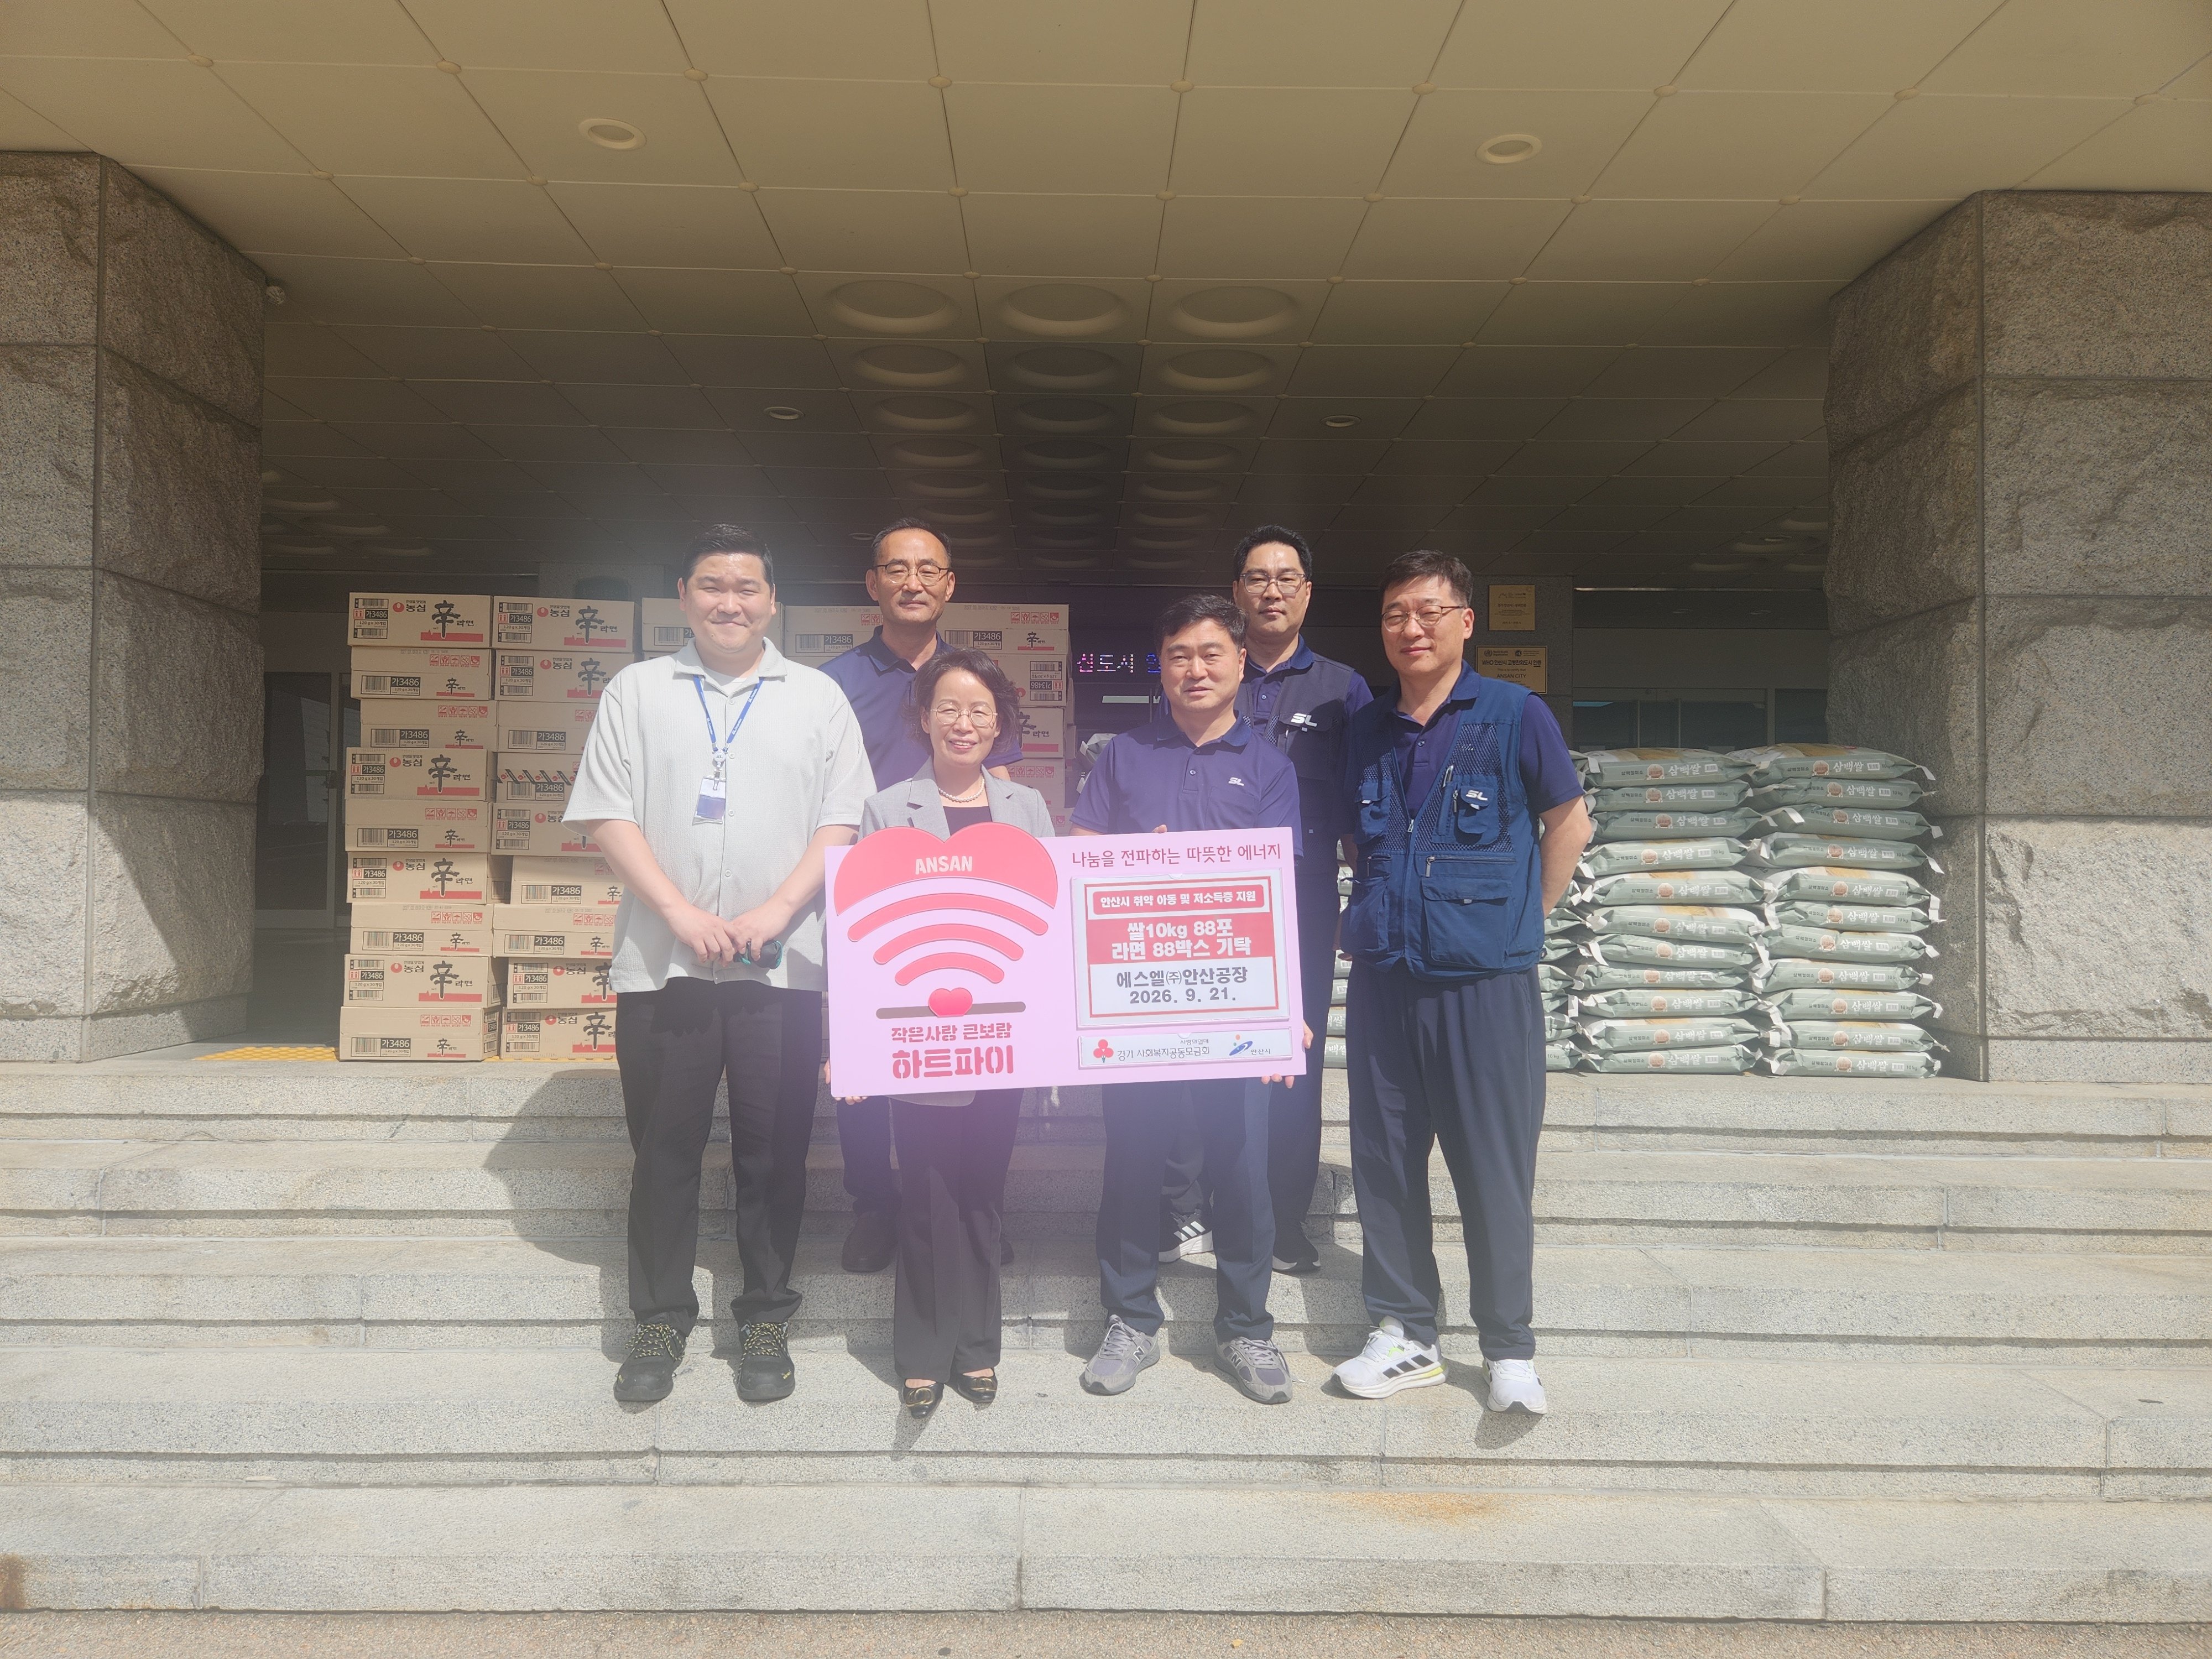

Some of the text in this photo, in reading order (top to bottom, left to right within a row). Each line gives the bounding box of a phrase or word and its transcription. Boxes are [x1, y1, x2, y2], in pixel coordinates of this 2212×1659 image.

[432, 600, 461, 638] 辛
[576, 606, 604, 643] 辛
[1027, 632, 1039, 648] 辛
[578, 658, 606, 695] 辛
[446, 678, 460, 694] 辛
[1291, 713, 1317, 727] SL
[455, 730, 467, 746] 辛
[429, 754, 457, 792] 辛
[1668, 764, 1701, 776] 삼백쌀
[1833, 761, 1864, 773] 삼백쌀
[1228, 778, 1244, 786] SL
[1466, 790, 1488, 801] SL
[1666, 789, 1698, 800] 삼백쌀
[1846, 785, 1875, 796] 삼백쌀
[1677, 816, 1709, 826] 삼백쌀
[1853, 813, 1882, 825] 삼백쌀
[445, 830, 458, 847] 辛
[1072, 843, 1281, 868] 나눔을 전파하는 따뜻한 에너지
[1662, 848, 1694, 860] 삼백쌀
[1848, 847, 1878, 858] 삼백쌀
[916, 856, 972, 875] ANSAN
[431, 858, 460, 896] 辛
[608, 886, 622, 902] 辛
[1678, 885, 1711, 896] 삼백쌀
[1853, 885, 1882, 896] 삼백쌀
[1100, 890, 1256, 907] 안산시 취약 아동 및 저소득층 지원
[1848, 911, 1879, 923] 삼백쌀
[1128, 919, 1233, 940] 쌀10kg 88포
[1675, 921, 1708, 934] 삼백쌀
[394, 933, 422, 942] 가3486
[450, 933, 463, 950] 辛
[591, 937, 604, 953] 辛
[1112, 937, 1251, 961] 라면 88박스 기탁
[1840, 940, 1872, 951] 삼백쌀
[1676, 947, 1708, 958] 삼백쌀
[430, 961, 459, 999] 辛
[1839, 971, 1869, 982] 삼백쌀
[1130, 987, 1236, 1004] 2026. 9. 21.
[1672, 998, 1703, 1010] 삼백쌀
[1852, 1000, 1882, 1012] 삼백쌀
[583, 1012, 612, 1049] 辛
[891, 1022, 1011, 1043] 작은사랑 큰보람
[1674, 1030, 1706, 1041] 삼백쌀
[1853, 1034, 1884, 1045] 삼백쌀
[437, 1039, 451, 1056] 辛
[1117, 1046, 1209, 1061] 경기 사회복지공동모금회
[1325, 1044, 1346, 1055] 백쌀
[892, 1045, 1014, 1079] 하트파이
[1669, 1054, 1701, 1065] 삼백쌀
[1856, 1060, 1888, 1072] 삼백쌀
